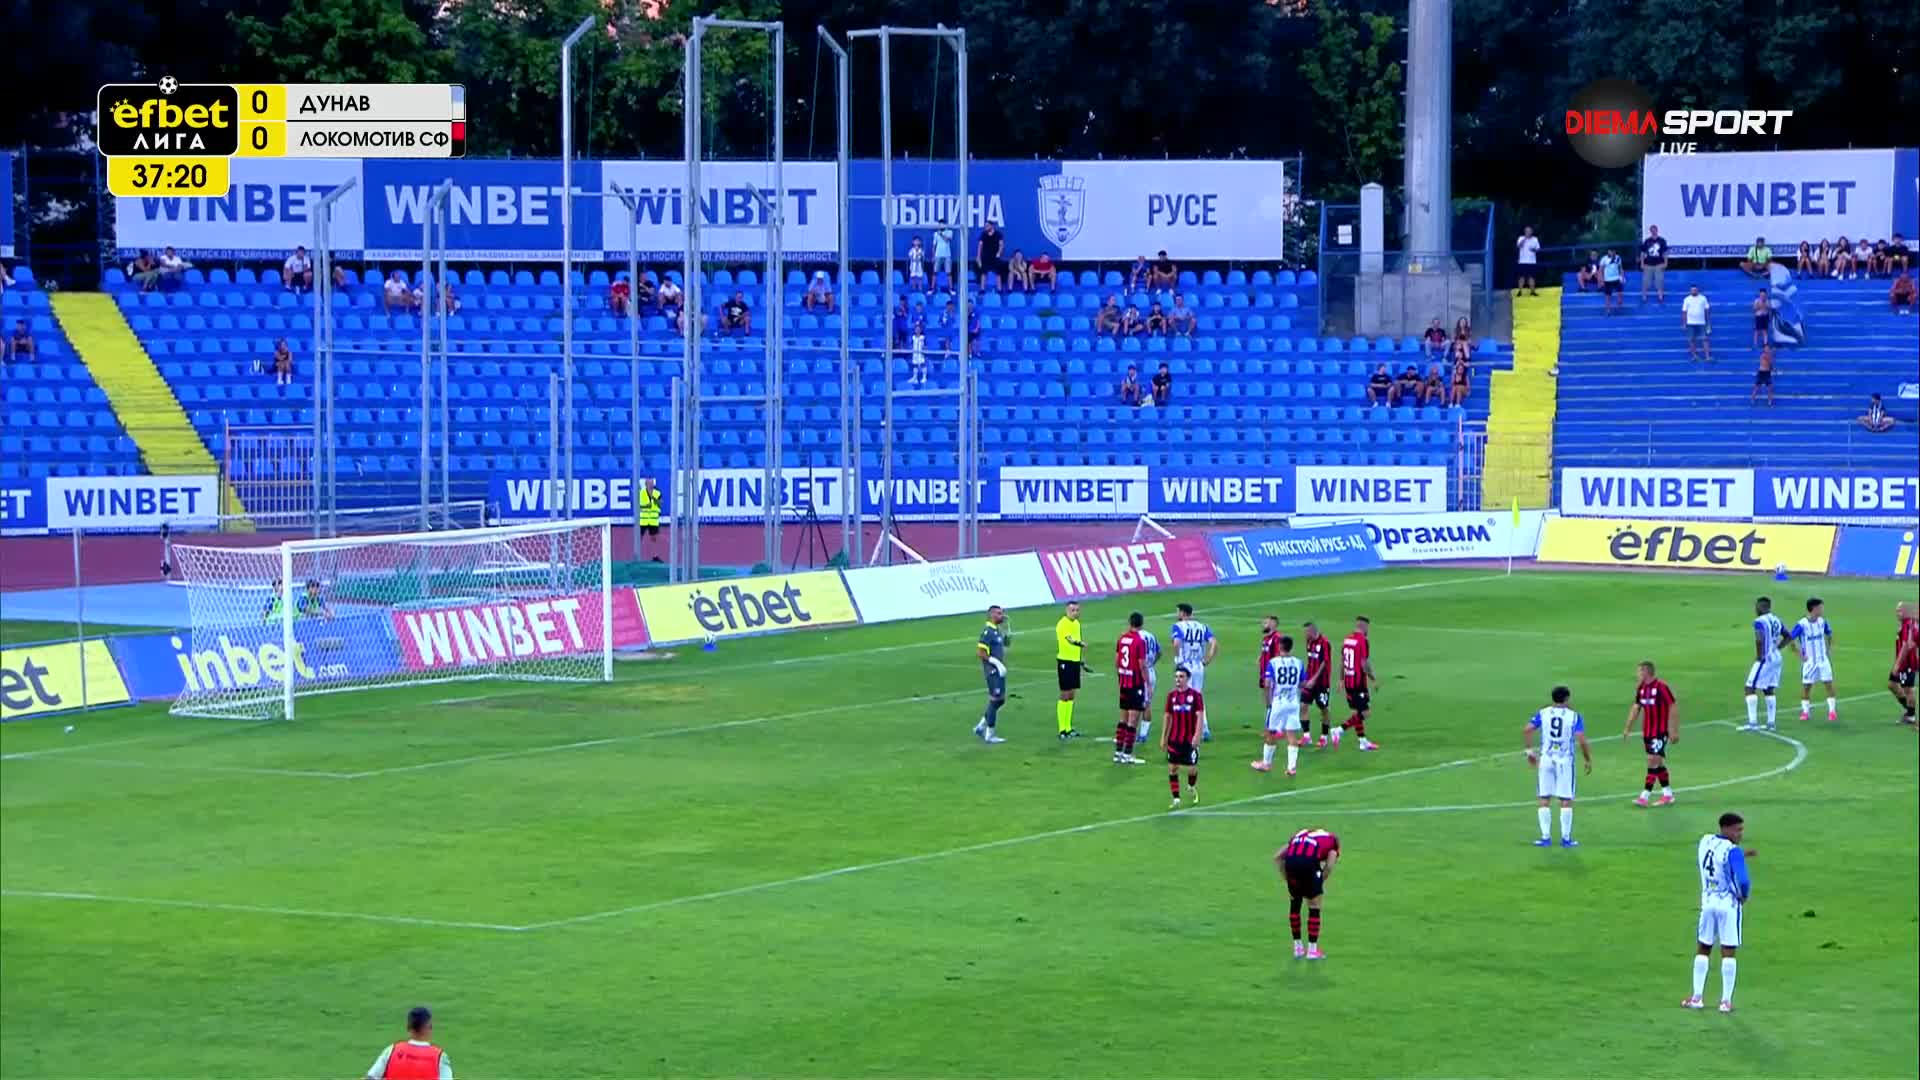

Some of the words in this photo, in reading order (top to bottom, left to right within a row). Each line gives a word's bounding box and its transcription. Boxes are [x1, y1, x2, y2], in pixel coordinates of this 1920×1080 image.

[1148, 194, 1218, 226] РУСЕ
[1680, 181, 1856, 217] WINBET
[64, 487, 202, 516] WINBET
[868, 479, 987, 505] WINBET
[1015, 479, 1134, 503] WINBET
[1161, 477, 1283, 503] WINBET
[1311, 478, 1432, 502] WINBET
[1581, 477, 1735, 507] WINBET
[1319, 536, 1347, 553] РУСЕ
[1609, 526, 1766, 565] efbet
[1047, 542, 1173, 595] WINBET
[693, 579, 812, 632] efbet
[405, 598, 585, 666] WINBET
[1185, 628, 1203, 646] 44
[1120, 645, 1130, 668] 3
[1277, 666, 1298, 685] 88
[1550, 717, 1563, 738] 9
[1703, 849, 1715, 877] 4
